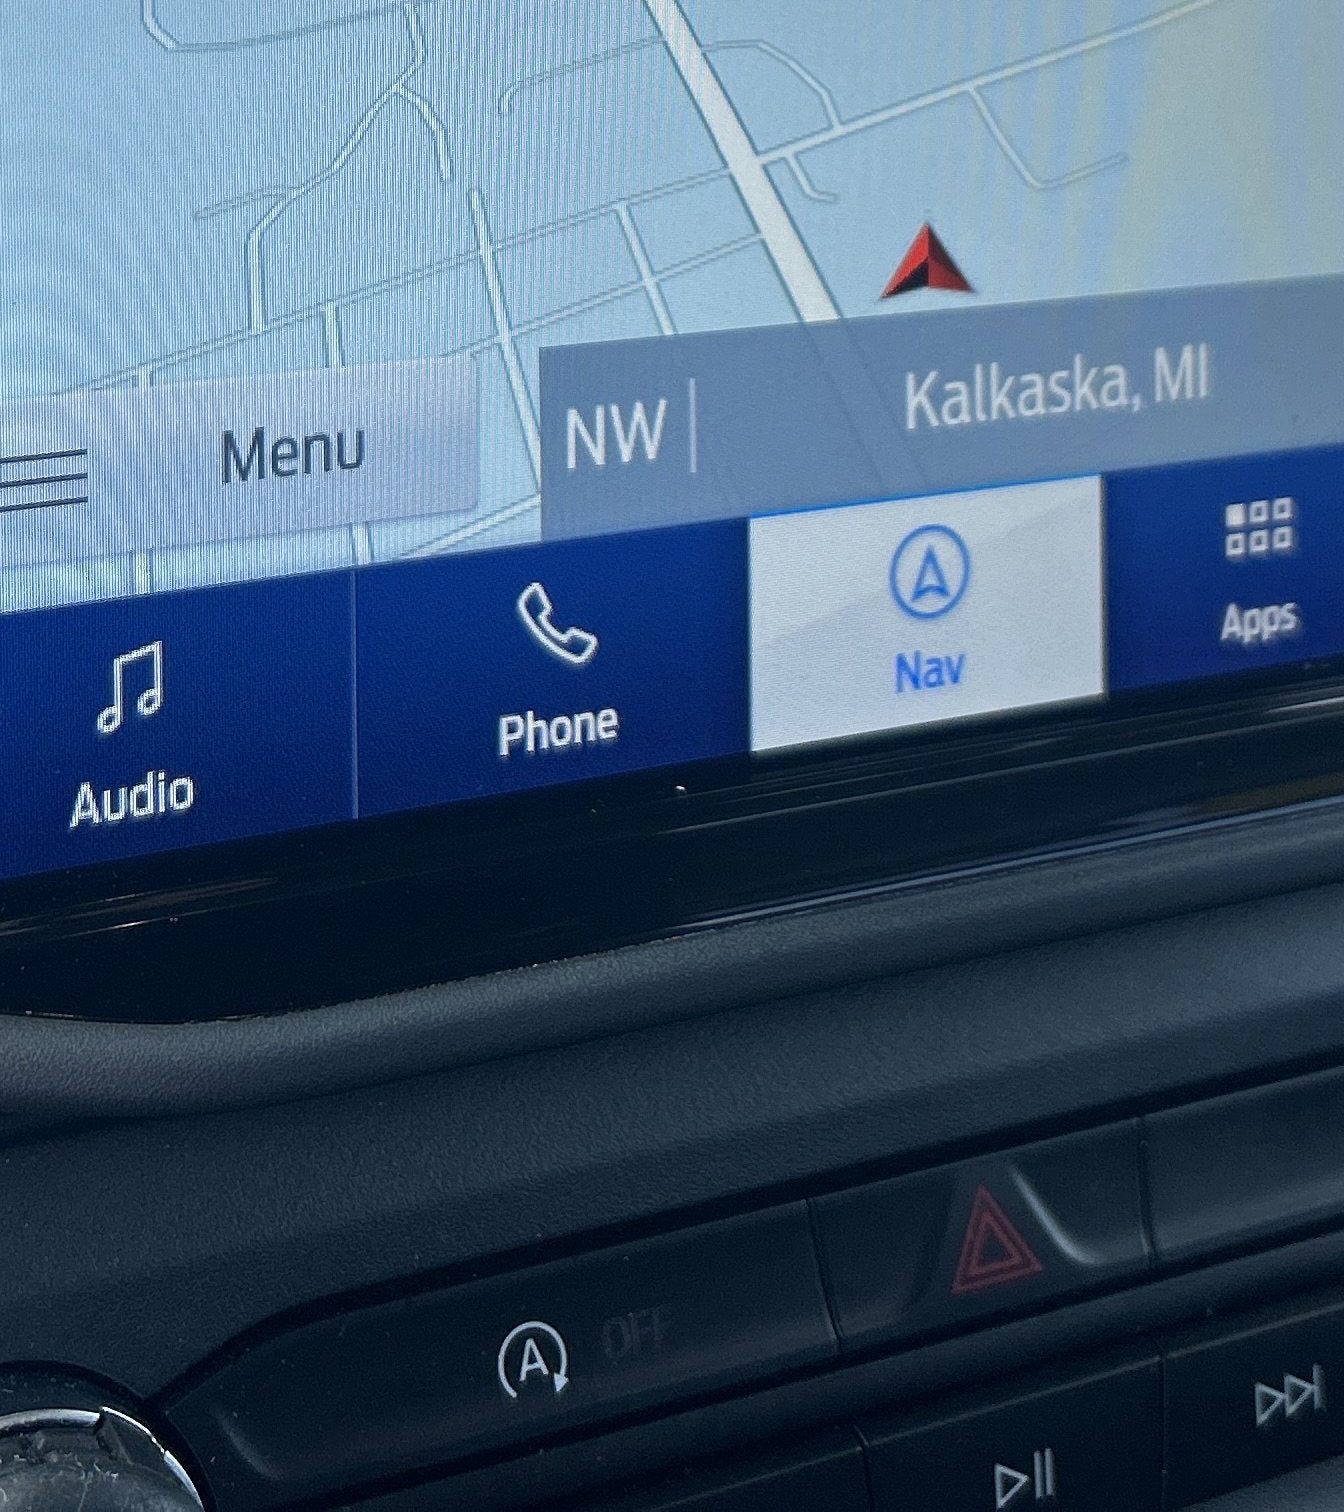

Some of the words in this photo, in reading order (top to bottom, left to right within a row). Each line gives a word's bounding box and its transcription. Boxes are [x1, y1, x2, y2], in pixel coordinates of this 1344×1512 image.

[904, 356, 1143, 430] Kalkaska,
[1154, 343, 1211, 402] MI
[220, 426, 366, 484] Menu
[566, 399, 668, 470] NW
[1221, 601, 1299, 644] Apps
[894, 651, 967, 694] Nav
[498, 707, 618, 757] Phone
[68, 770, 195, 829] Audio
